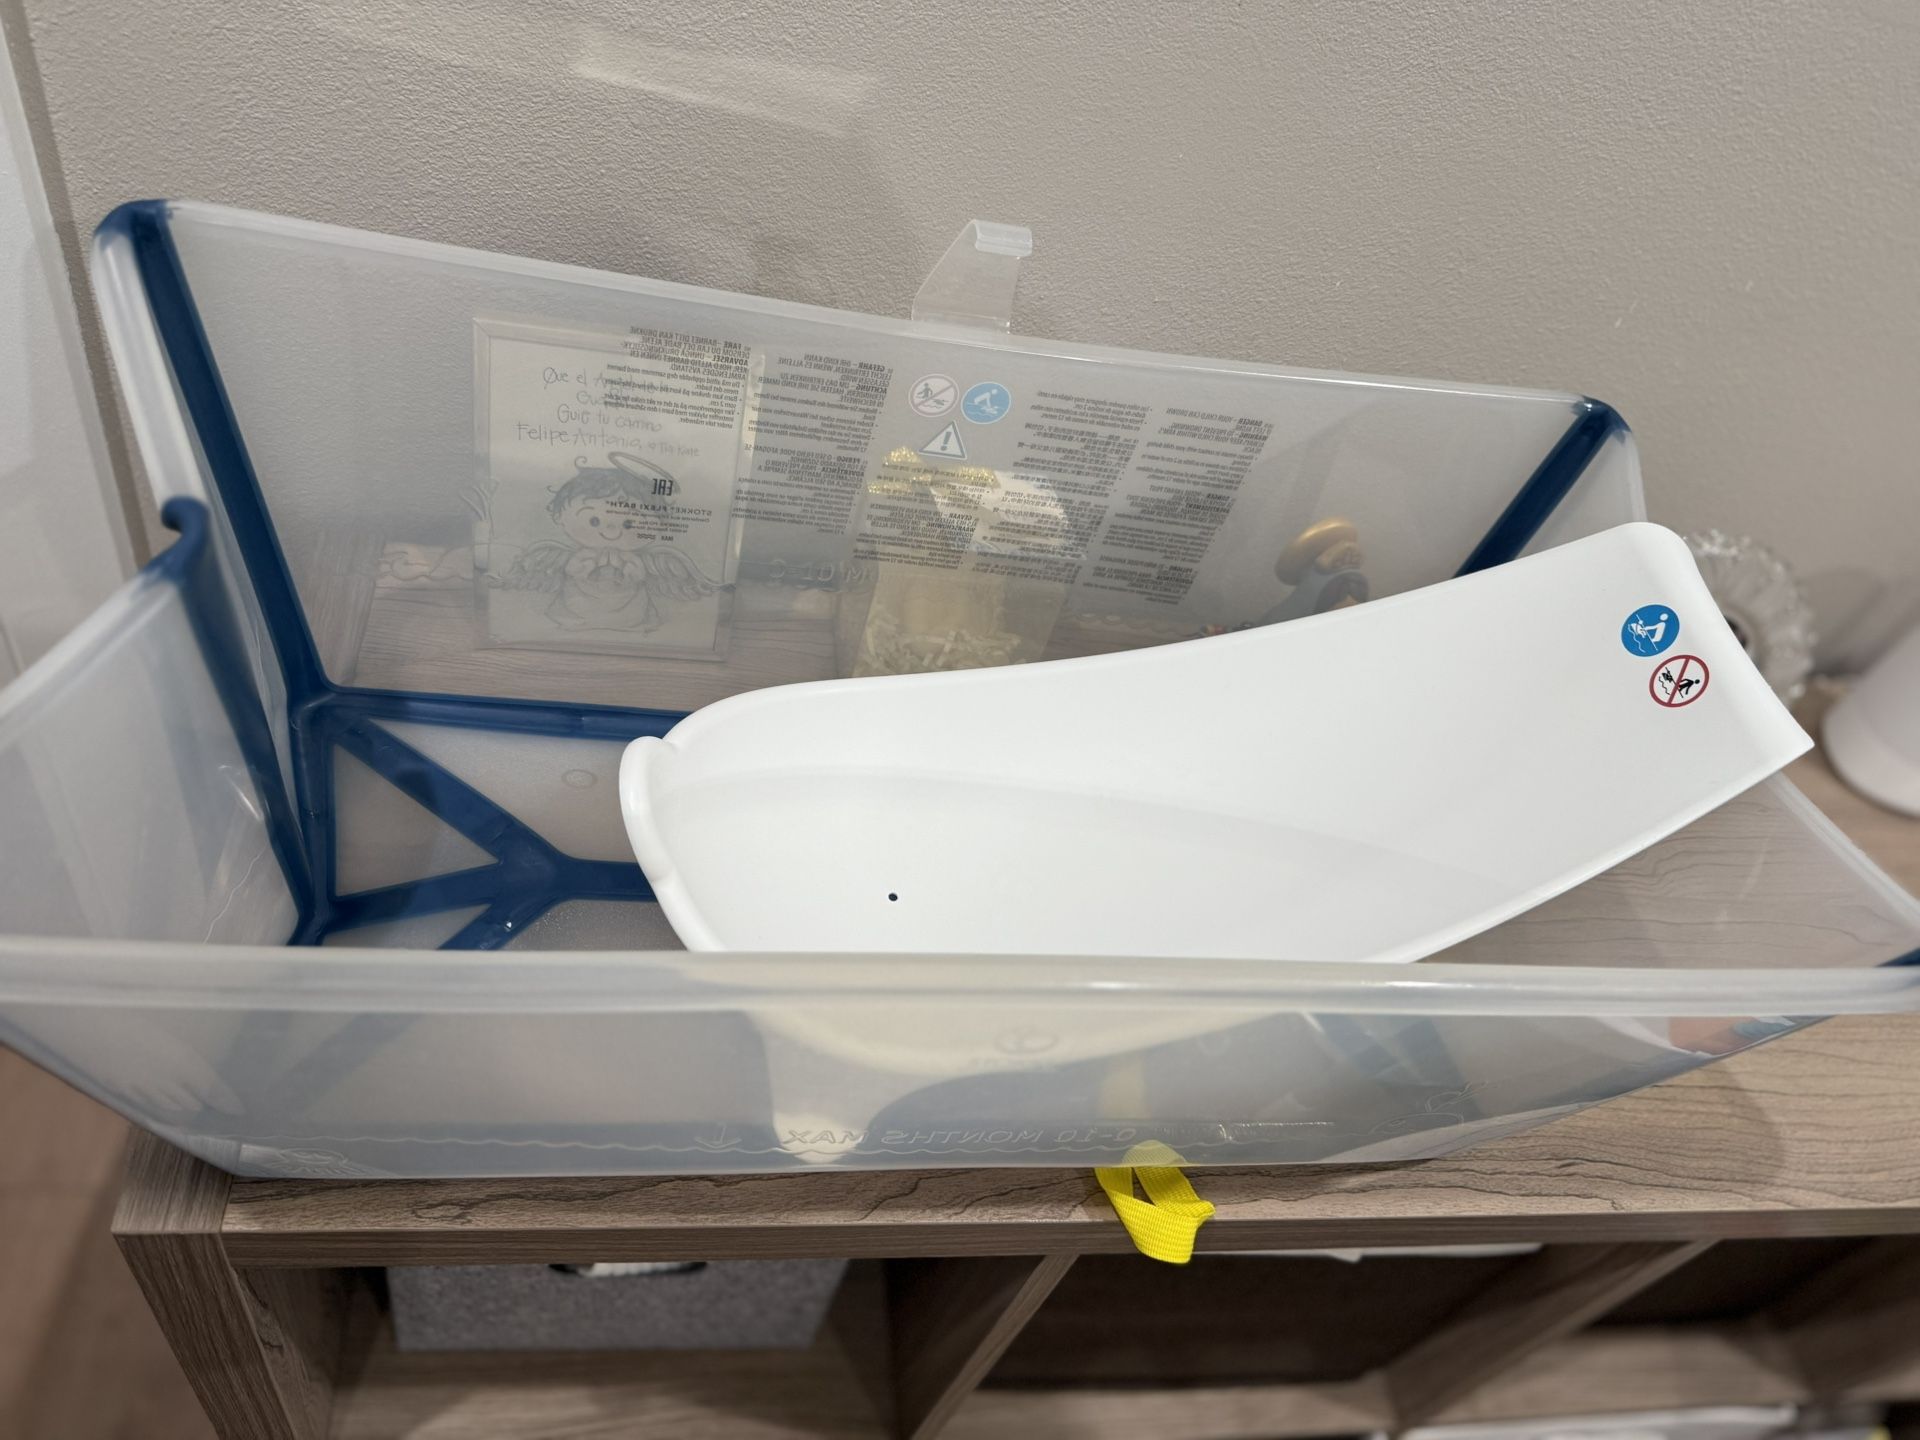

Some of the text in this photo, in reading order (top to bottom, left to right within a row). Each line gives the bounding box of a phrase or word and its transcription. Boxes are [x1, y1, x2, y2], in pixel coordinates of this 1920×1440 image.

[576, 368, 587, 386] el
[598, 410, 610, 425] tu
[513, 421, 569, 446] Felipe
